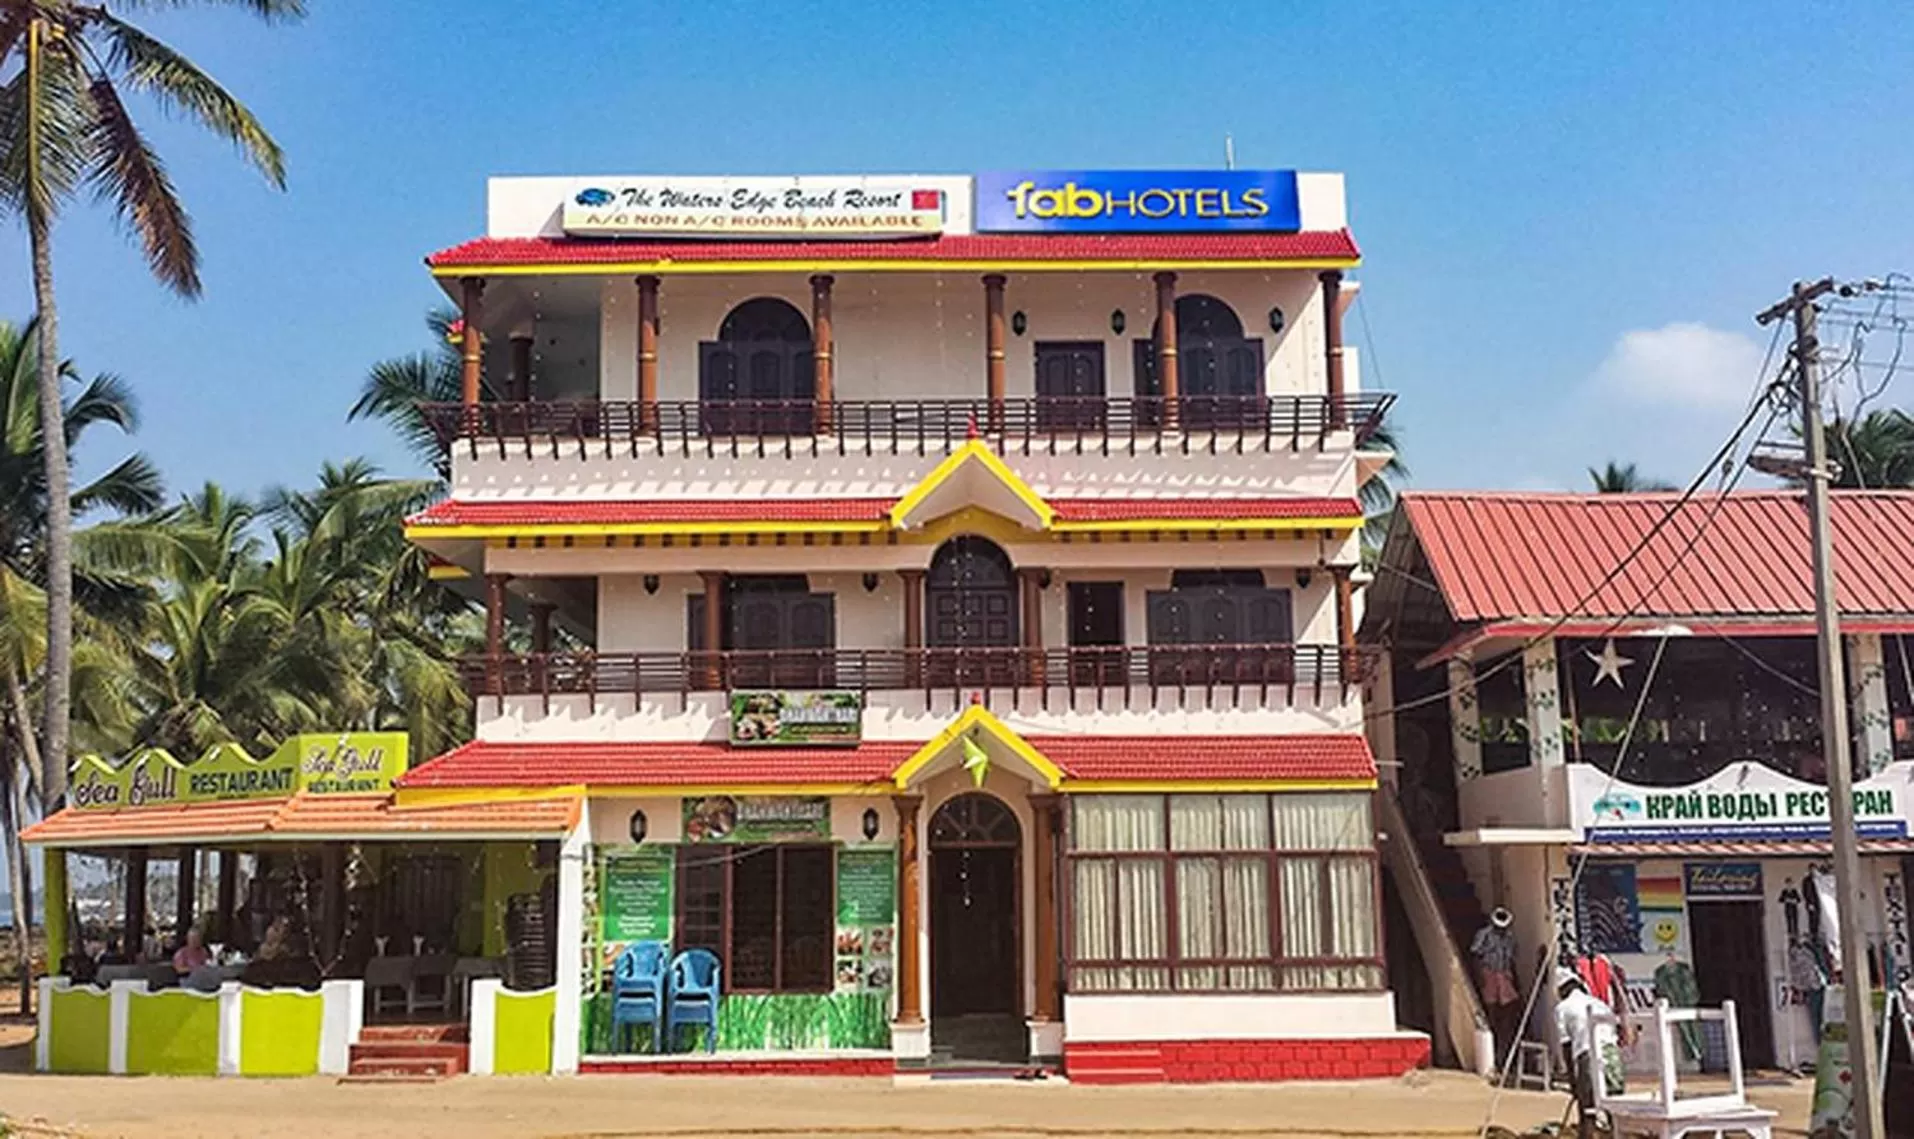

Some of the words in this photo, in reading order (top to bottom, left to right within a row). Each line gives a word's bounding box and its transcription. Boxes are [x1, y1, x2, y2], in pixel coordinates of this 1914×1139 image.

[620, 187, 653, 209] The
[657, 188, 723, 209] Waters
[731, 188, 779, 213] Edge
[783, 188, 836, 210] Beach
[843, 188, 903, 209] Resort
[1007, 181, 1269, 219] fabHOTELS
[586, 213, 629, 226] A/C
[634, 213, 678, 226] NON
[683, 214, 727, 227] A/C
[731, 215, 808, 228] ROOMS
[811, 214, 923, 227] AVAILABLE
[75, 770, 120, 805] Sea
[128, 762, 176, 806] Gull
[189, 767, 294, 796] RESTAURANT
[1646, 790, 1701, 820] КРАЙ
[1707, 792, 1778, 821] ВОДЫ
[1786, 790, 1893, 817] РЕСРАН
